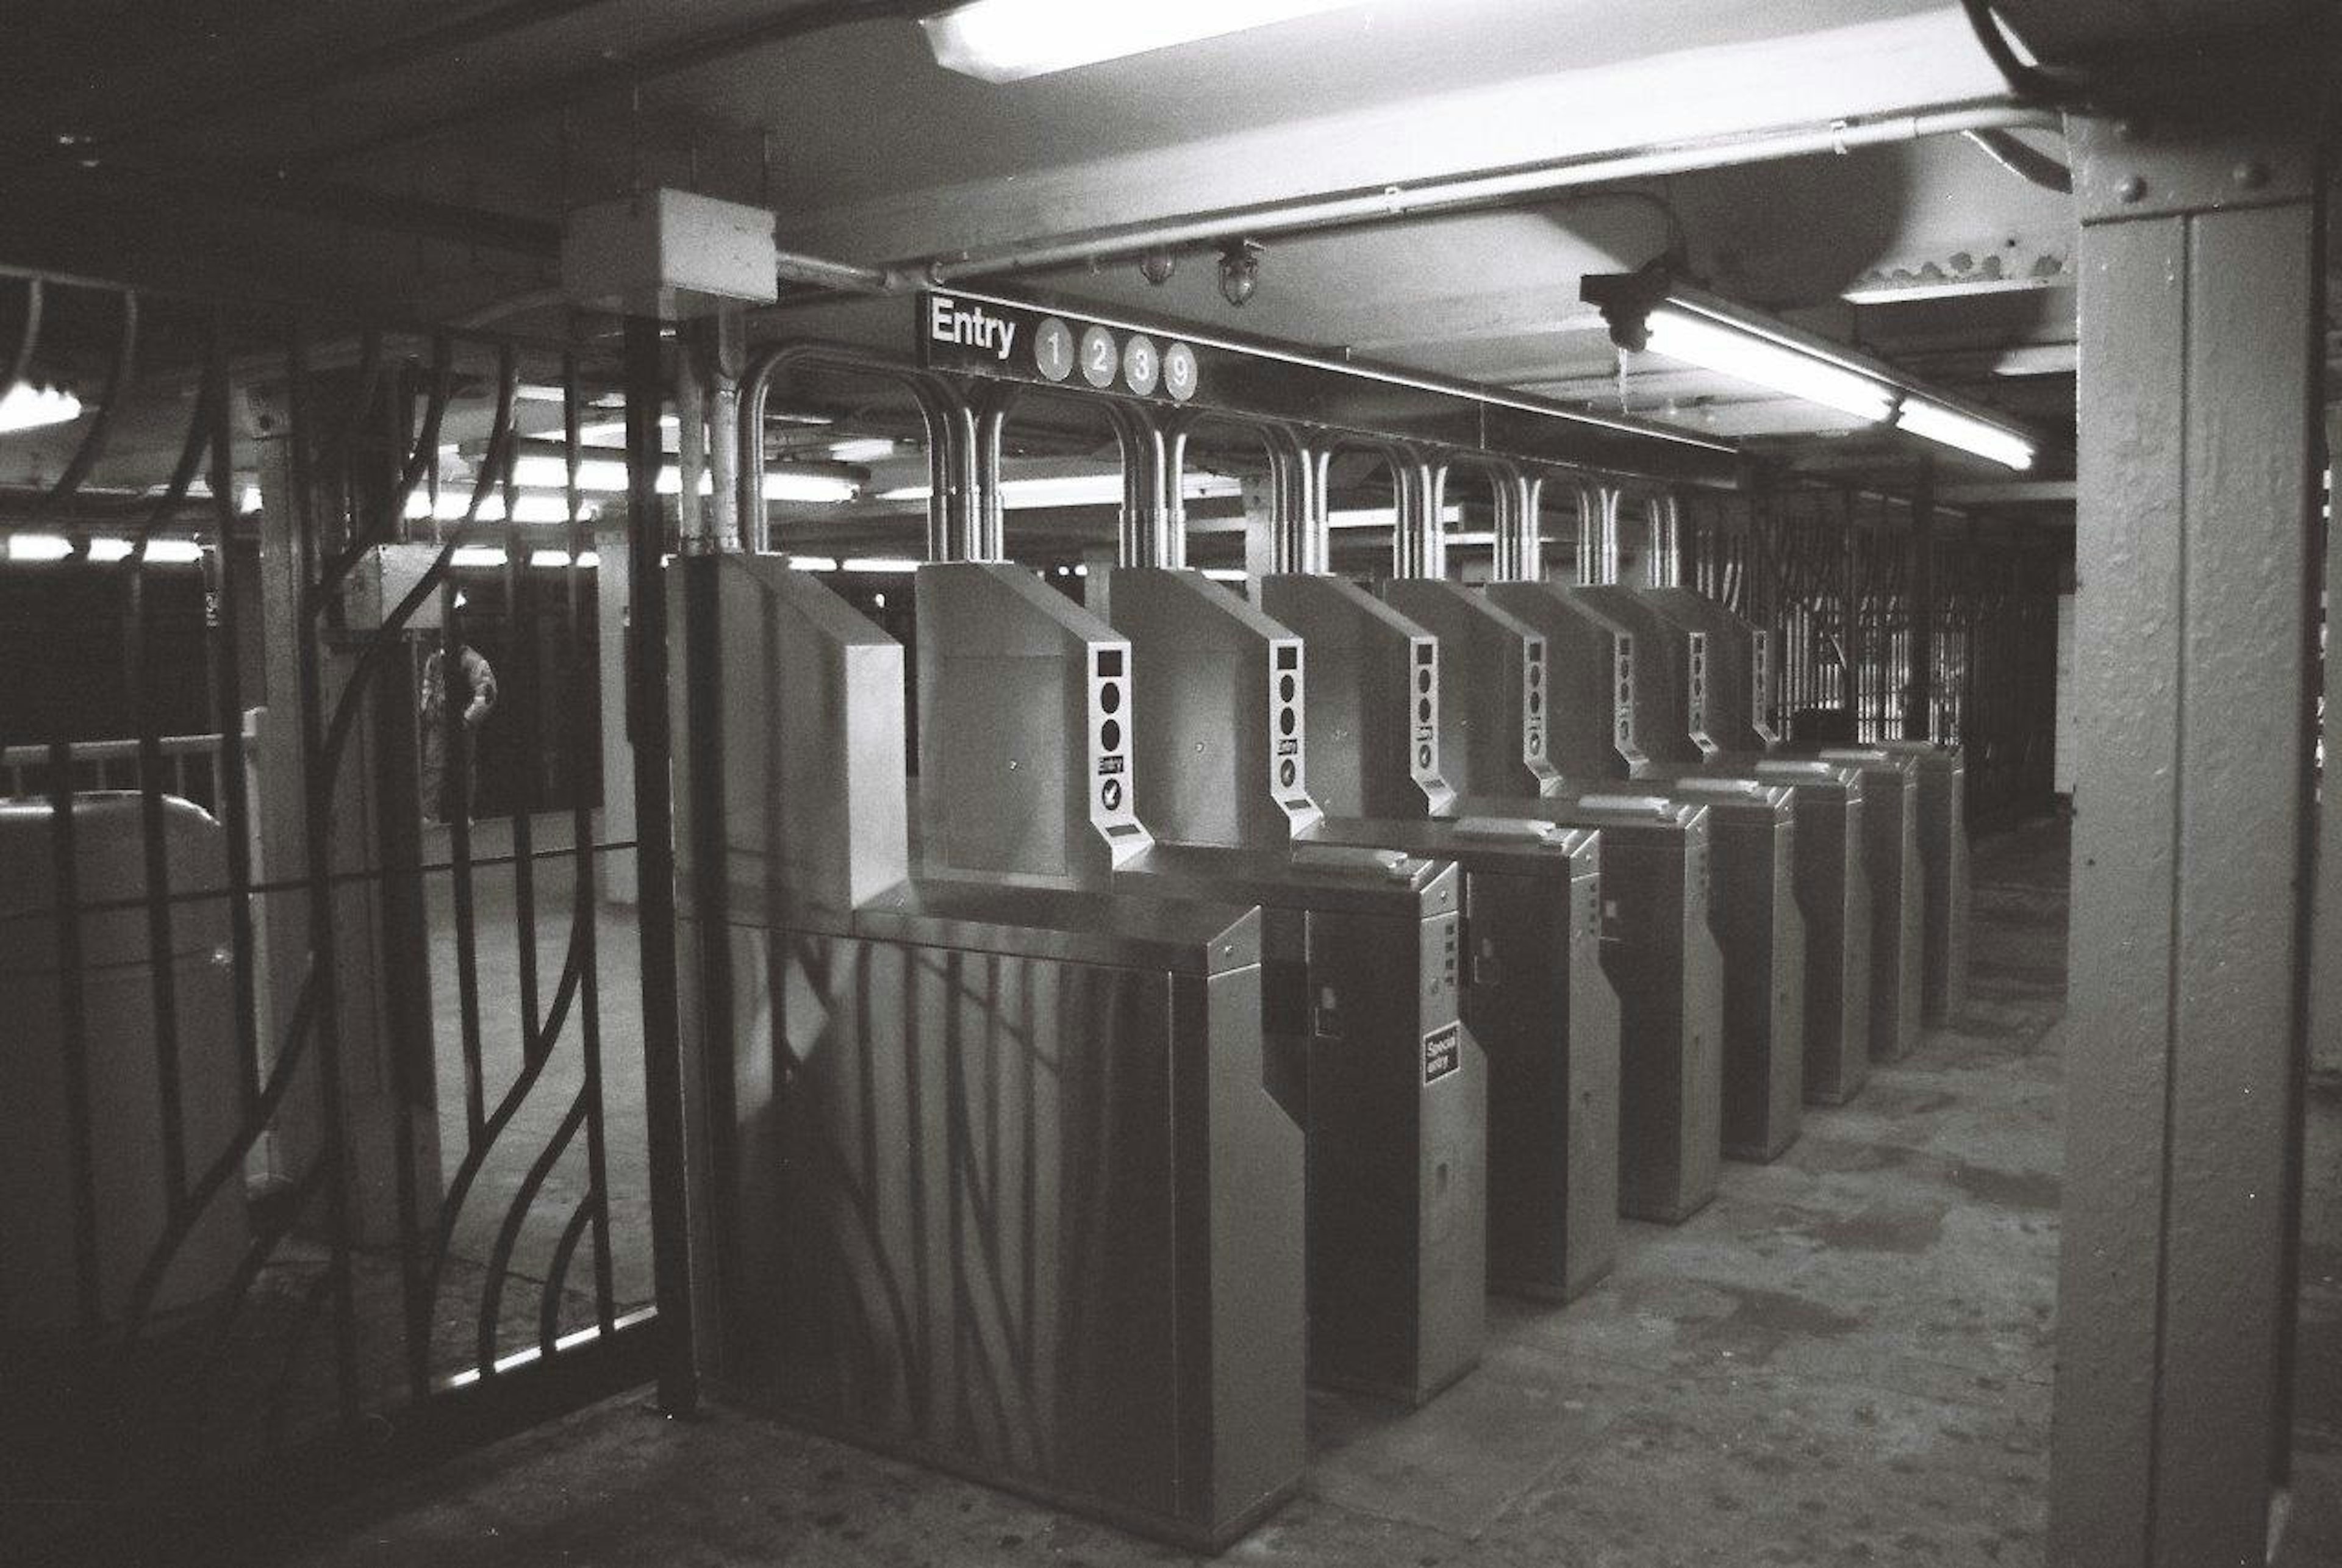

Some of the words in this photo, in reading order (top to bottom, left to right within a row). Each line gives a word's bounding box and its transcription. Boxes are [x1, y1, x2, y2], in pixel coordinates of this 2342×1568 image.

[932, 296, 1015, 360] Entry
[1048, 332, 1059, 365] 1
[1093, 338, 1108, 372] 2
[1136, 349, 1150, 381] 3
[1173, 356, 1188, 386] 9
